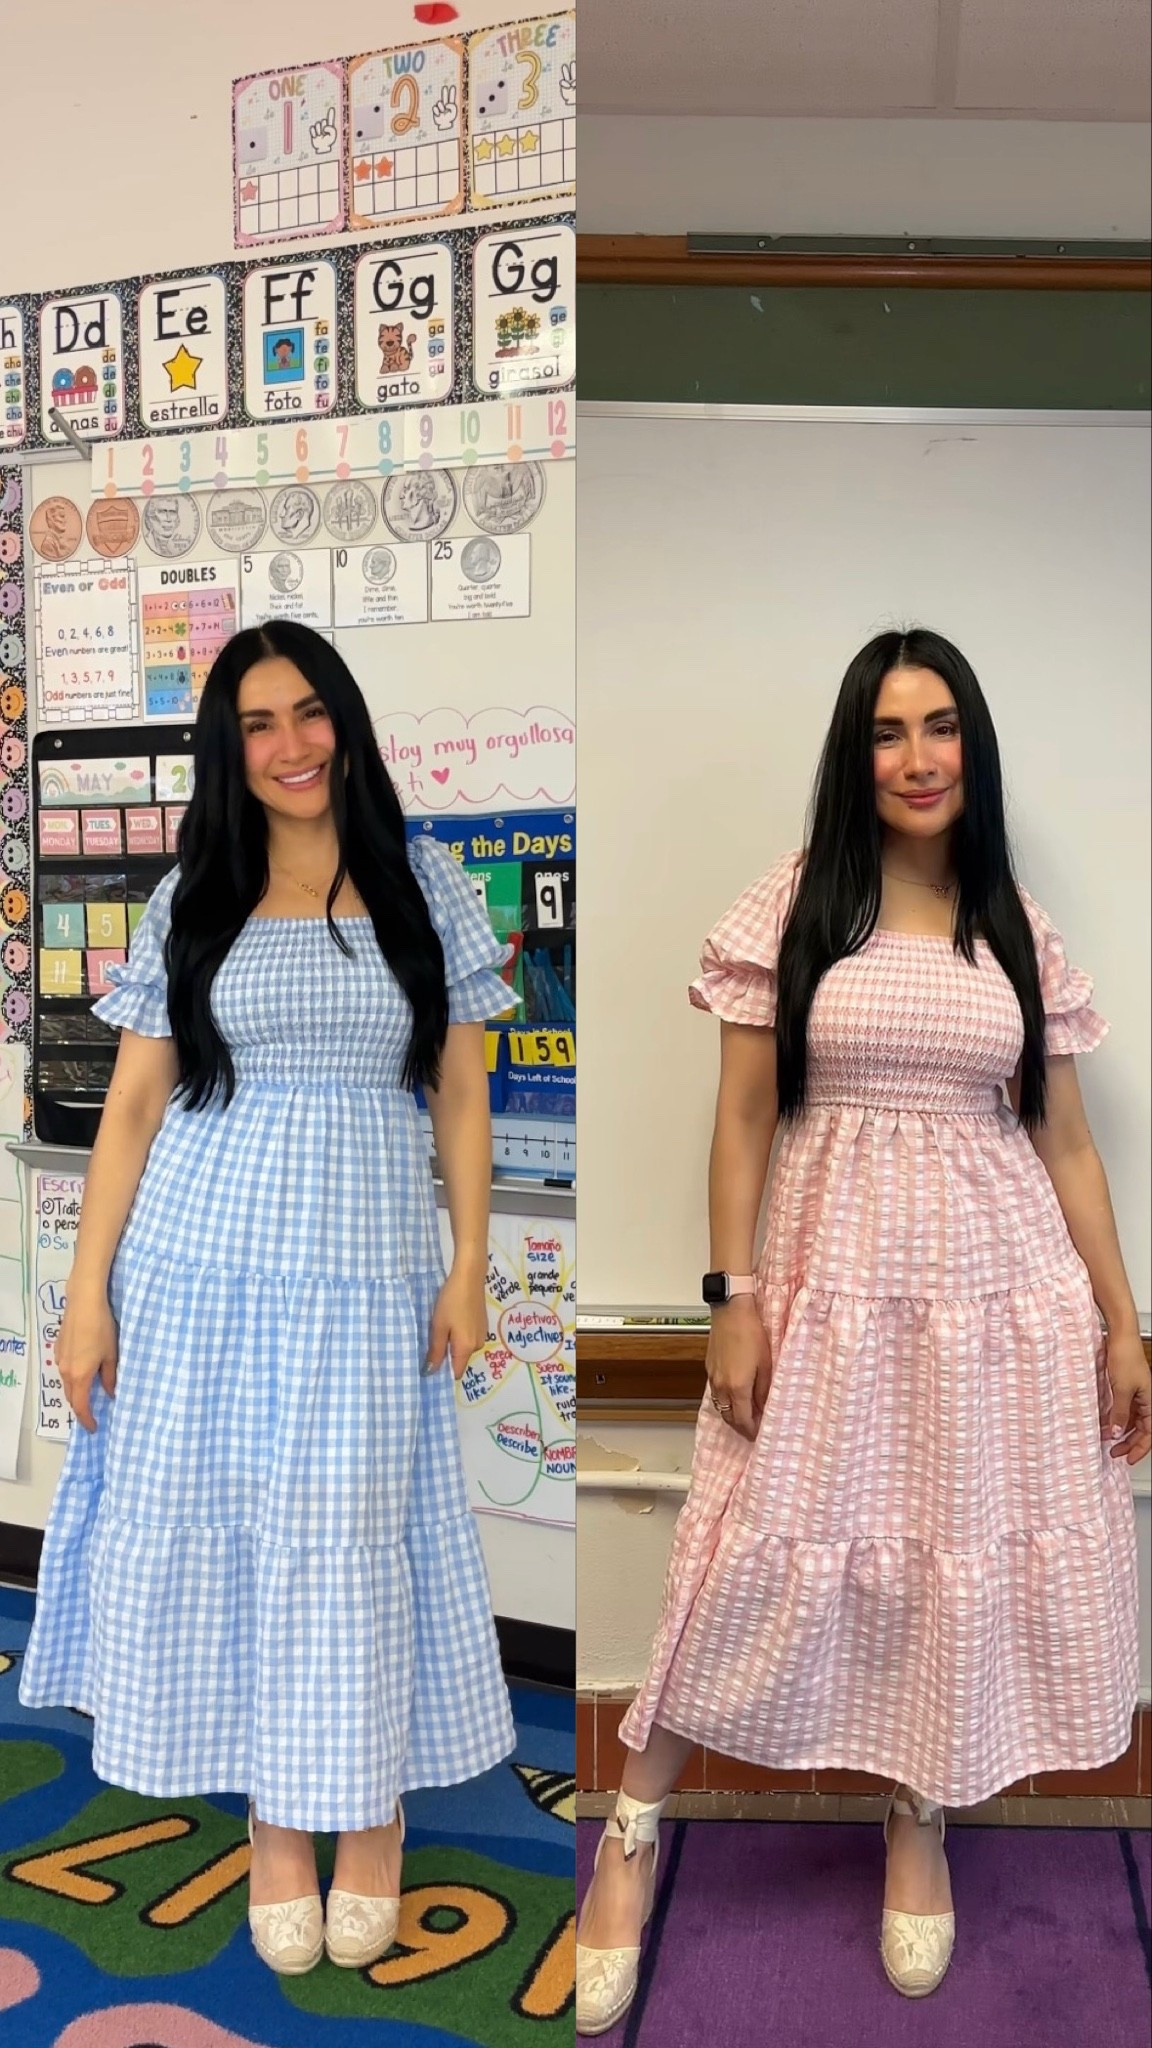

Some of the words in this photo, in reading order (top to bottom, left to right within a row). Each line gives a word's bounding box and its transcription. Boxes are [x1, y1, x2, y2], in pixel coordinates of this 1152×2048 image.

[496, 24, 560, 57] THREE
[382, 51, 426, 79] TWO
[268, 75, 306, 100] ONE
[515, 51, 542, 110] 3
[389, 74, 421, 136] 2
[284, 101, 293, 155] 1
[492, 242, 558, 303] Gg
[265, 270, 316, 323] Ff
[373, 260, 435, 320] Gg
[157, 290, 208, 340] Ee
[56, 300, 106, 353] Dd
[315, 322, 329, 336] fa
[428, 324, 445, 338] ga
[315, 340, 328, 354] fe
[428, 343, 445, 357] go
[102, 352, 116, 364] da
[102, 366, 117, 380] de
[315, 374, 329, 388] fo
[489, 355, 560, 389] girasol
[104, 385, 115, 398] di
[378, 377, 420, 403] gato
[103, 401, 117, 415] do
[150, 396, 219, 422] estrella
[264, 391, 302, 411] foto
[315, 395, 329, 408] fu
[50, 414, 99, 432] dnas
[104, 419, 118, 432] du
[108, 447, 114, 478] 1
[141, 444, 155, 476] 2
[180, 441, 191, 473] 3
[215, 436, 228, 468] 4
[257, 433, 269, 465] 5
[296, 428, 308, 461] 6
[336, 425, 349, 458] 7
[378, 420, 392, 454] 8
[420, 415, 434, 448] 9
[460, 409, 481, 444] 10
[507, 404, 522, 440] 11
[547, 400, 567, 436] 12
[336, 549, 347, 568] 10
[434, 541, 453, 560] 25
[243, 555, 253, 573] 5
[161, 567, 216, 585] DOUBLES
[43, 582, 75, 595] Even
[78, 581, 94, 592] or
[45, 647, 67, 658] Even
[45, 690, 64, 702] Odd
[434, 737, 477, 766] muy
[486, 722, 574, 759] orgullosa
[76, 773, 113, 791] MAY
[42, 836, 77, 846] MONDAY
[85, 836, 118, 847] TUESDAY
[471, 835, 506, 858] the
[512, 832, 573, 859] Days
[540, 885, 557, 920] 9
[56, 914, 71, 938] 4
[101, 913, 113, 938] 5
[54, 960, 66, 984] 11
[508, 1071, 526, 1082] Days
[527, 1073, 542, 1082] Left
[543, 1074, 550, 1082] of
[552, 1075, 576, 1085] School
[504, 1147, 510, 1156] 8
[523, 1149, 529, 1157] 9
[541, 1150, 550, 1159] 10
[563, 1152, 570, 1160] 11
[524, 1236, 562, 1252] Tamaño
[527, 1268, 560, 1286] grande
[495, 1281, 522, 1302] verde
[528, 1283, 563, 1297] pequeño
[508, 1312, 558, 1330] Adjetivos
[508, 1326, 564, 1349] Adjectives
[536, 1363, 565, 1374] Suena
[42, 1372, 63, 1389] Los
[462, 1371, 487, 1391] looks
[541, 1374, 552, 1386] It
[42, 1389, 63, 1408] Los
[41, 1411, 60, 1429] Los
[497, 1433, 539, 1457] Describe
